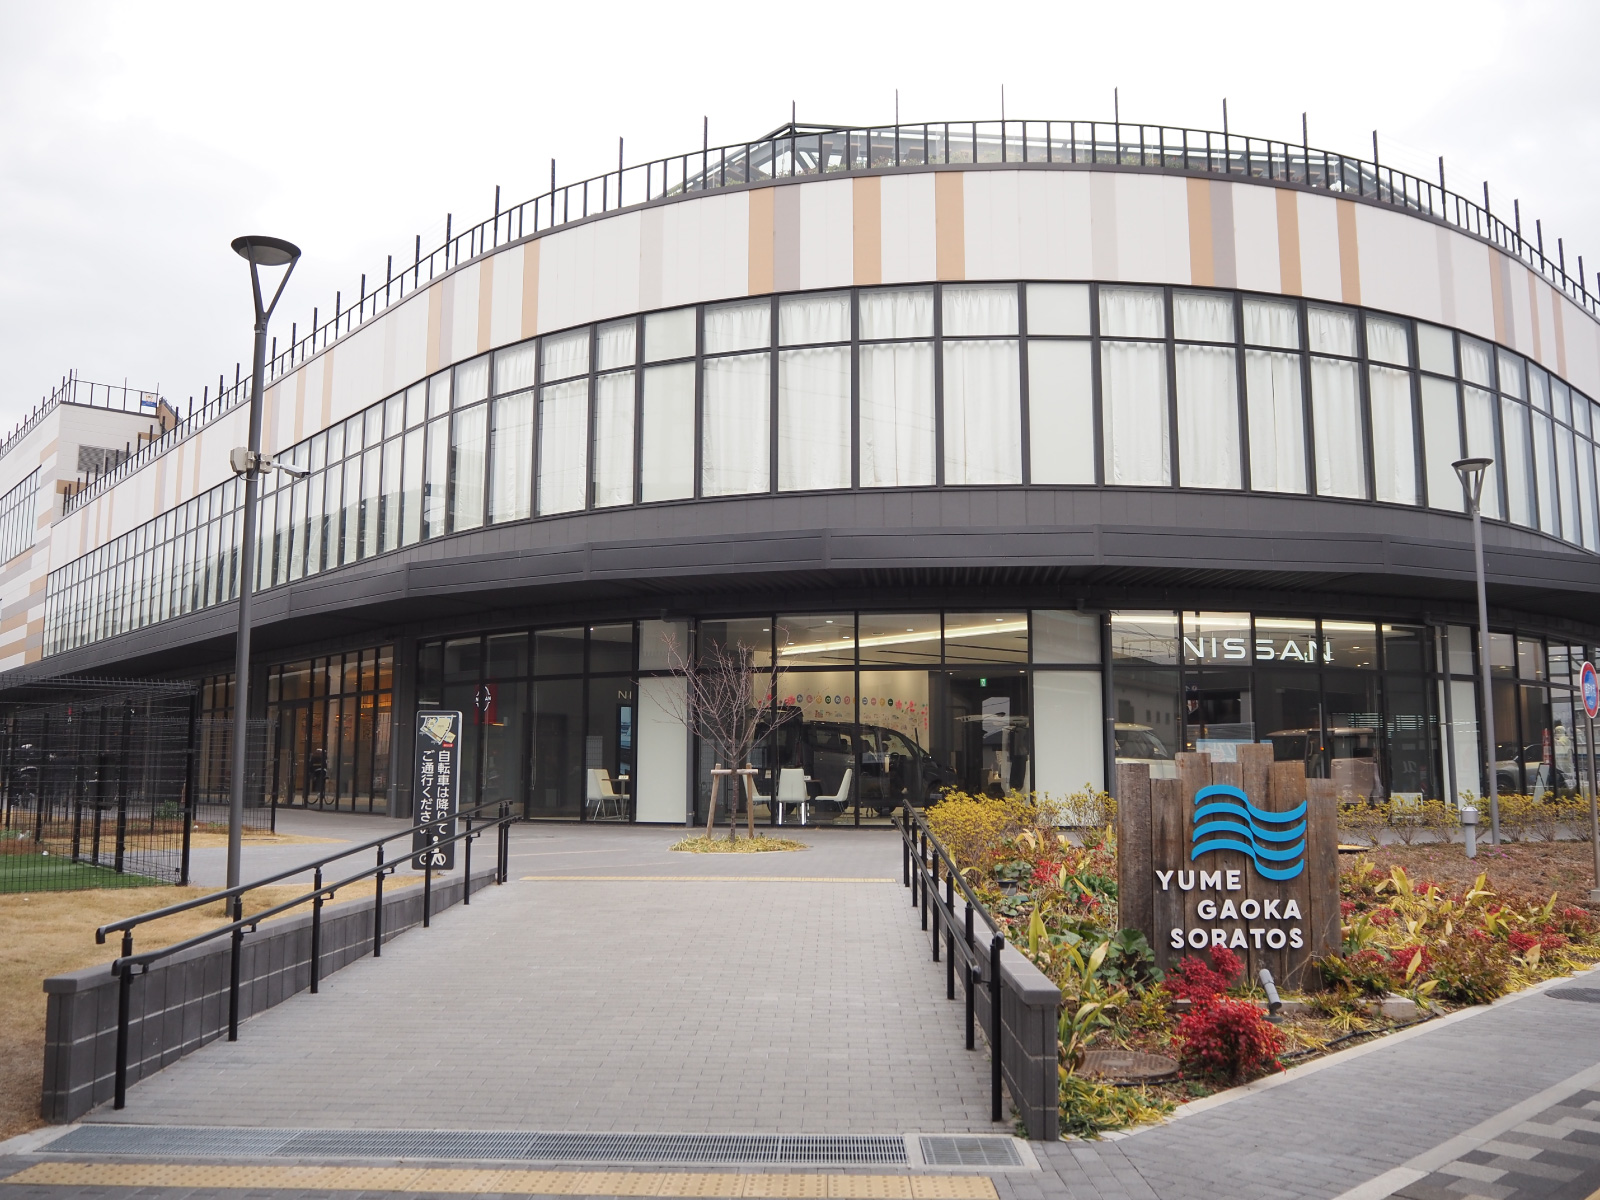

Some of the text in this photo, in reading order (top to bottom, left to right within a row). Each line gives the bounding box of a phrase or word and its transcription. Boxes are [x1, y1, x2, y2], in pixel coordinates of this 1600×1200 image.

[1183, 637, 1331, 662] NISSAN
[436, 750, 451, 835] 自転車は降りて
[1155, 870, 1242, 891] YUME
[1197, 899, 1302, 921] GAOKA
[1170, 928, 1304, 949] SORATOS
